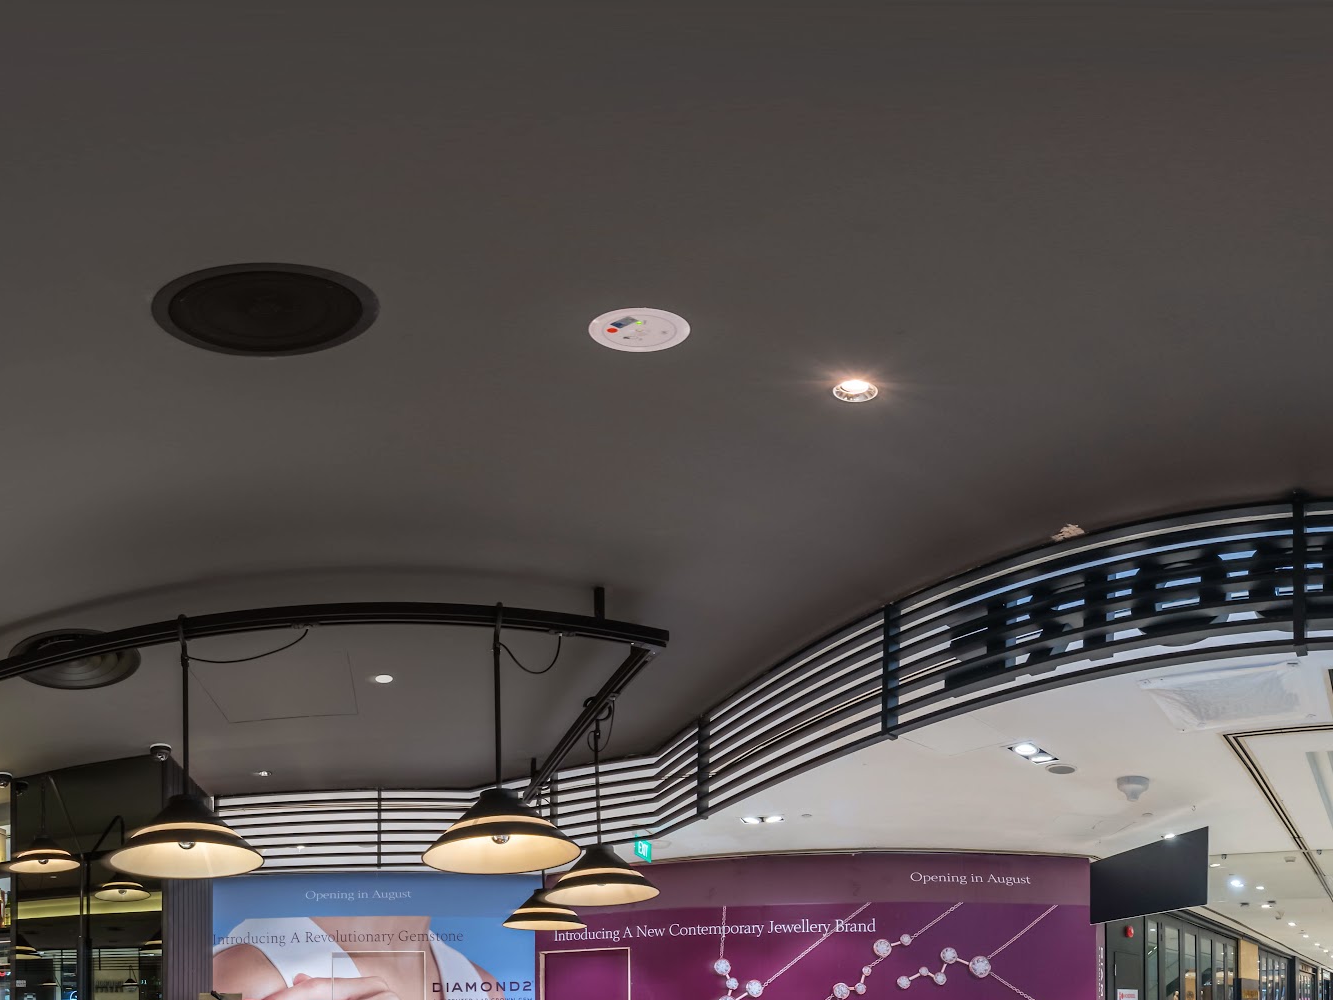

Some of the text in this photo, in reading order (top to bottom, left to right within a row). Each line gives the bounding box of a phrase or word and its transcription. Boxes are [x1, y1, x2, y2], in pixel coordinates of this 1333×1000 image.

[910, 872, 1031, 886] Opening in August
[305, 889, 412, 901] Opening in August
[554, 918, 876, 943] Introducing A New Contemporary Jewellery Brand
[213, 930, 464, 947] Introducing A Revolutionary Gemstone
[432, 981, 532, 993] DIAMOND2
